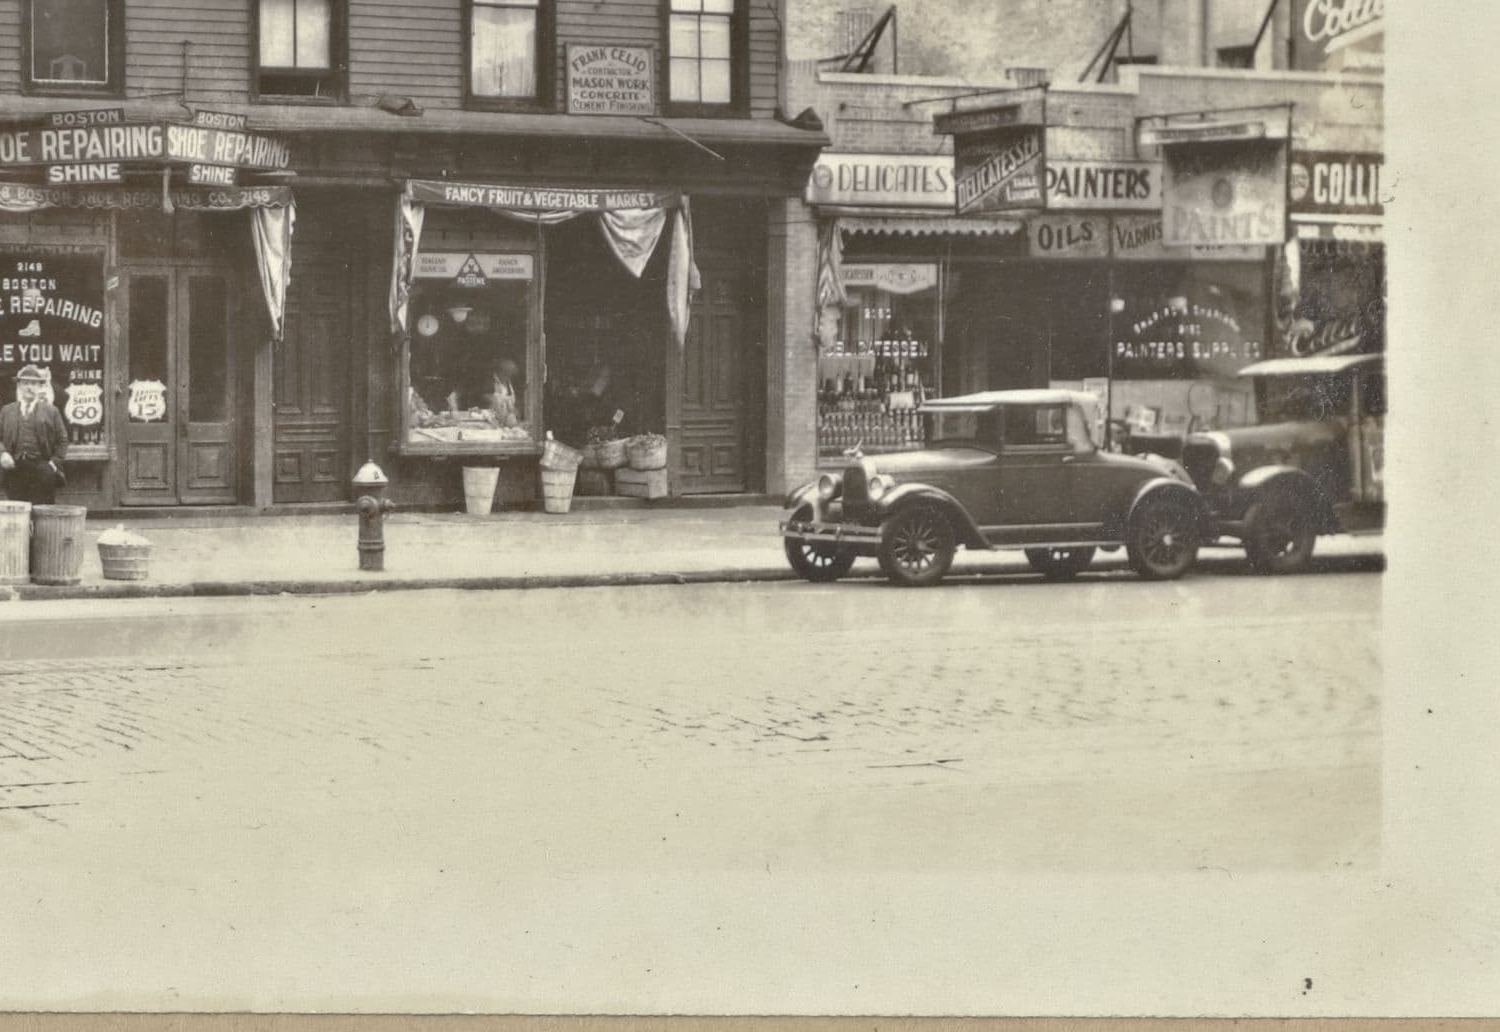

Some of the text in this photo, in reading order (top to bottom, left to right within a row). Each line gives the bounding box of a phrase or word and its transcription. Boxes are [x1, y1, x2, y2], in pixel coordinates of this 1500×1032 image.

[572, 48, 646, 72] FRANK CELIO
[572, 77, 649, 90] MASON WORK
[572, 98, 606, 111] CEMENT
[580, 90, 639, 100] CONCRETE
[52, 110, 120, 125] BOSTON
[197, 113, 246, 128] BOSTON
[41, 126, 163, 161] REPAIRING
[167, 129, 290, 168] SHOE REPAIRING
[49, 163, 121, 183] SHINE
[191, 165, 235, 184] SHINE
[837, 162, 952, 193] DELICATES
[1047, 168, 1150, 200] PAINTERS
[17, 187, 70, 202] BOSTON
[123, 191, 201, 205] REPAING
[208, 192, 232, 204] CO.
[241, 190, 270, 203] 2148
[445, 187, 655, 208] FANCY FRUIT & VEGETABLE MARKET
[1171, 202, 1276, 241] PAINTS
[1037, 221, 1094, 251] OILS
[1115, 223, 1163, 250] VARNIS
[17, 262, 43, 272] 2148
[2, 278, 57, 291] BOSTON
[10, 295, 103, 328] REPAIRING
[19, 344, 53, 362] YOU
[59, 344, 101, 362] WAIT
[1115, 341, 1261, 360] PAINTERS SUPPLES
[69, 370, 103, 380] SHINE
[72, 406, 99, 420] 60
